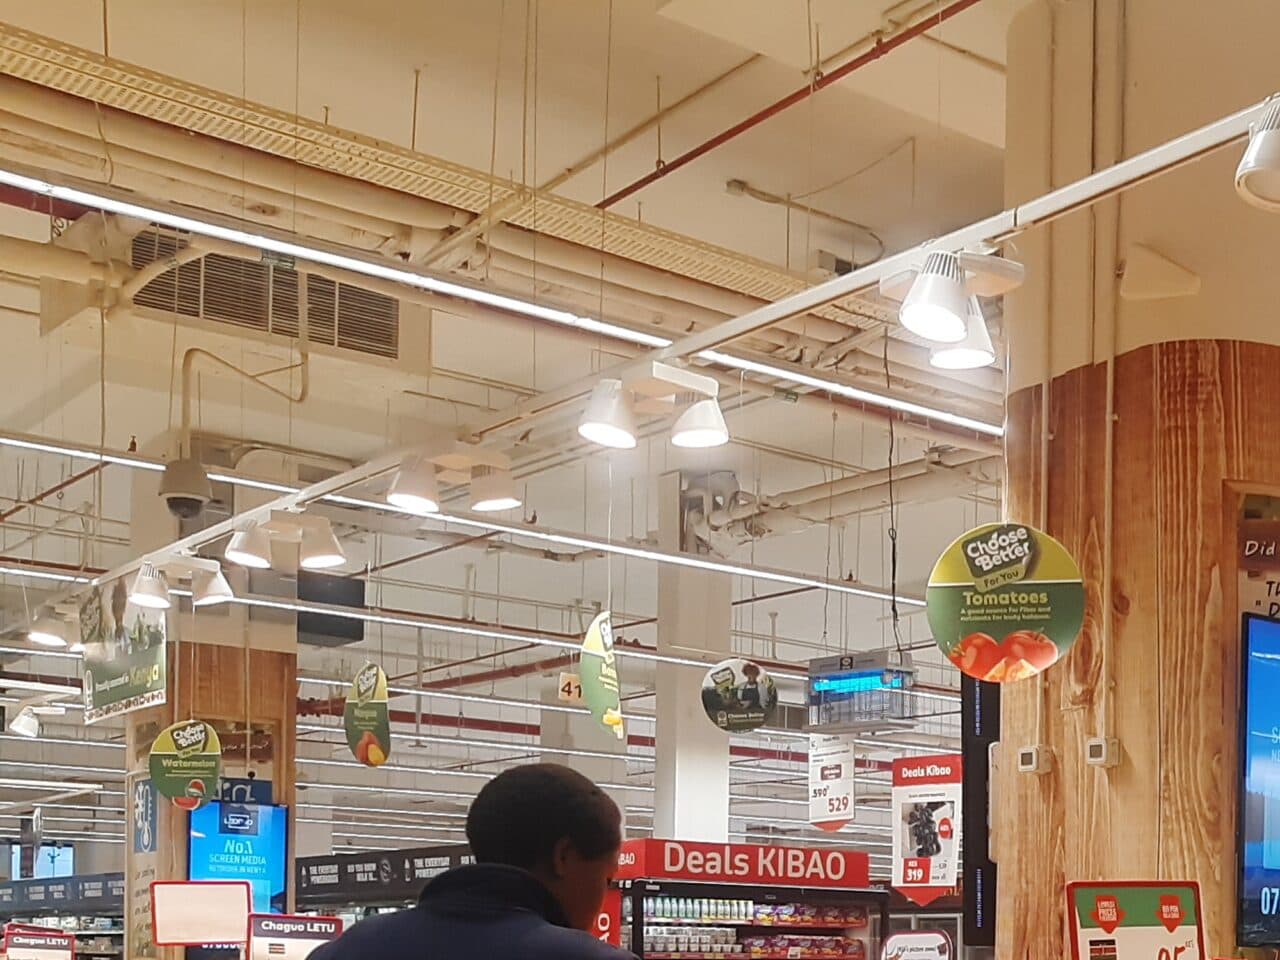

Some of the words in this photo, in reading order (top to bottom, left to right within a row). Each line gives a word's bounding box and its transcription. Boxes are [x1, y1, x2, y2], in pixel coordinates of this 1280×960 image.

[967, 527, 1028, 558] Choose
[1245, 540, 1276, 556] Did
[974, 542, 1030, 571] Better
[983, 576, 999, 588] For
[1000, 570, 1019, 582] You
[962, 591, 1049, 606] Tomatoes
[901, 765, 925, 778] Deals
[925, 764, 952, 777] Kibao
[828, 798, 849, 813] 529
[224, 840, 253, 854] No.1
[209, 854, 240, 865] SCREEN
[241, 856, 267, 865] MEDIA
[618, 852, 635, 865] BAO
[664, 841, 750, 876] Deals
[757, 847, 846, 881] KIBAO
[907, 868, 924, 881] 319
[261, 920, 304, 933] Chaguo
[306, 921, 336, 933] LETU
